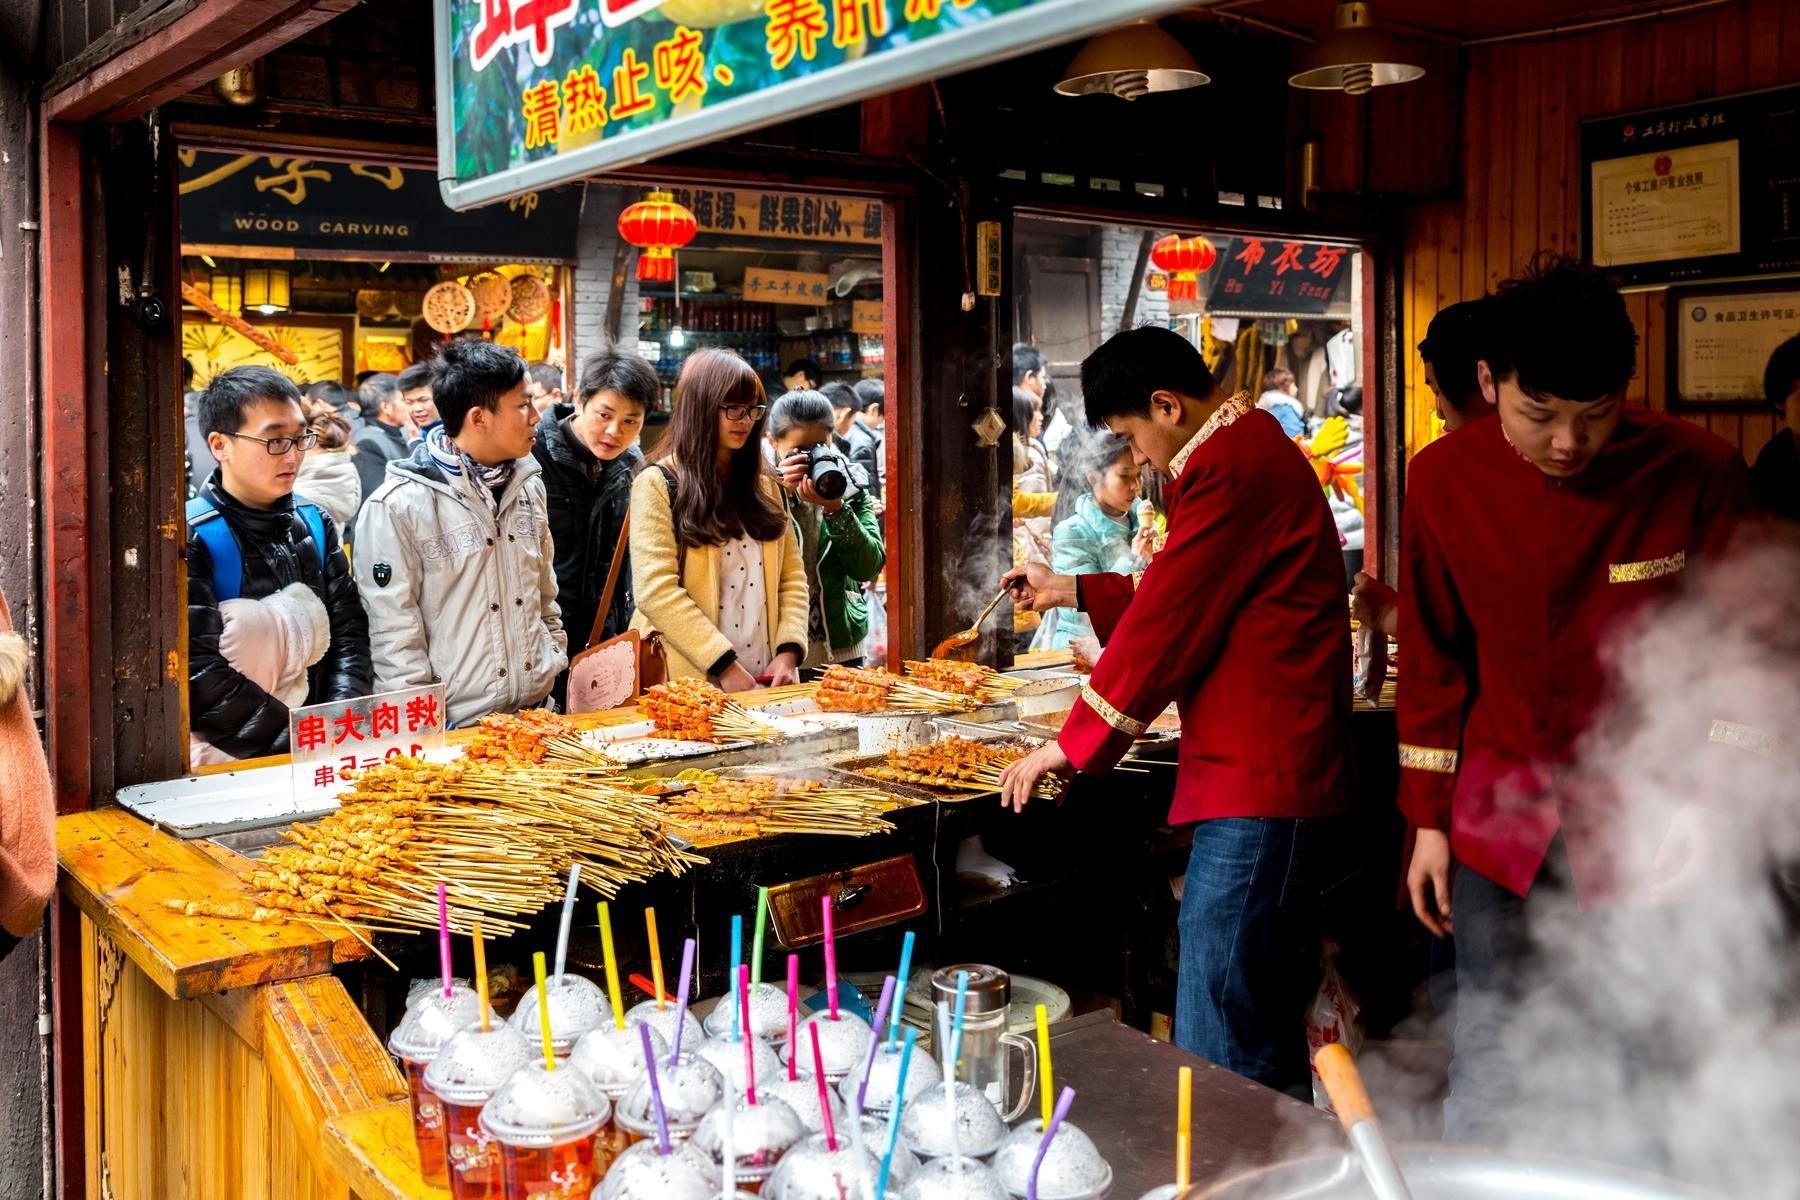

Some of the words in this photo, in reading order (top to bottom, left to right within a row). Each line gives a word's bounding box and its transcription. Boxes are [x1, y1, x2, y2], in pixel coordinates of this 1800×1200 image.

[234, 218, 300, 232] WOOD
[319, 222, 409, 236] CARVING
[1715, 308, 1795, 323] 食品卫生许可证
